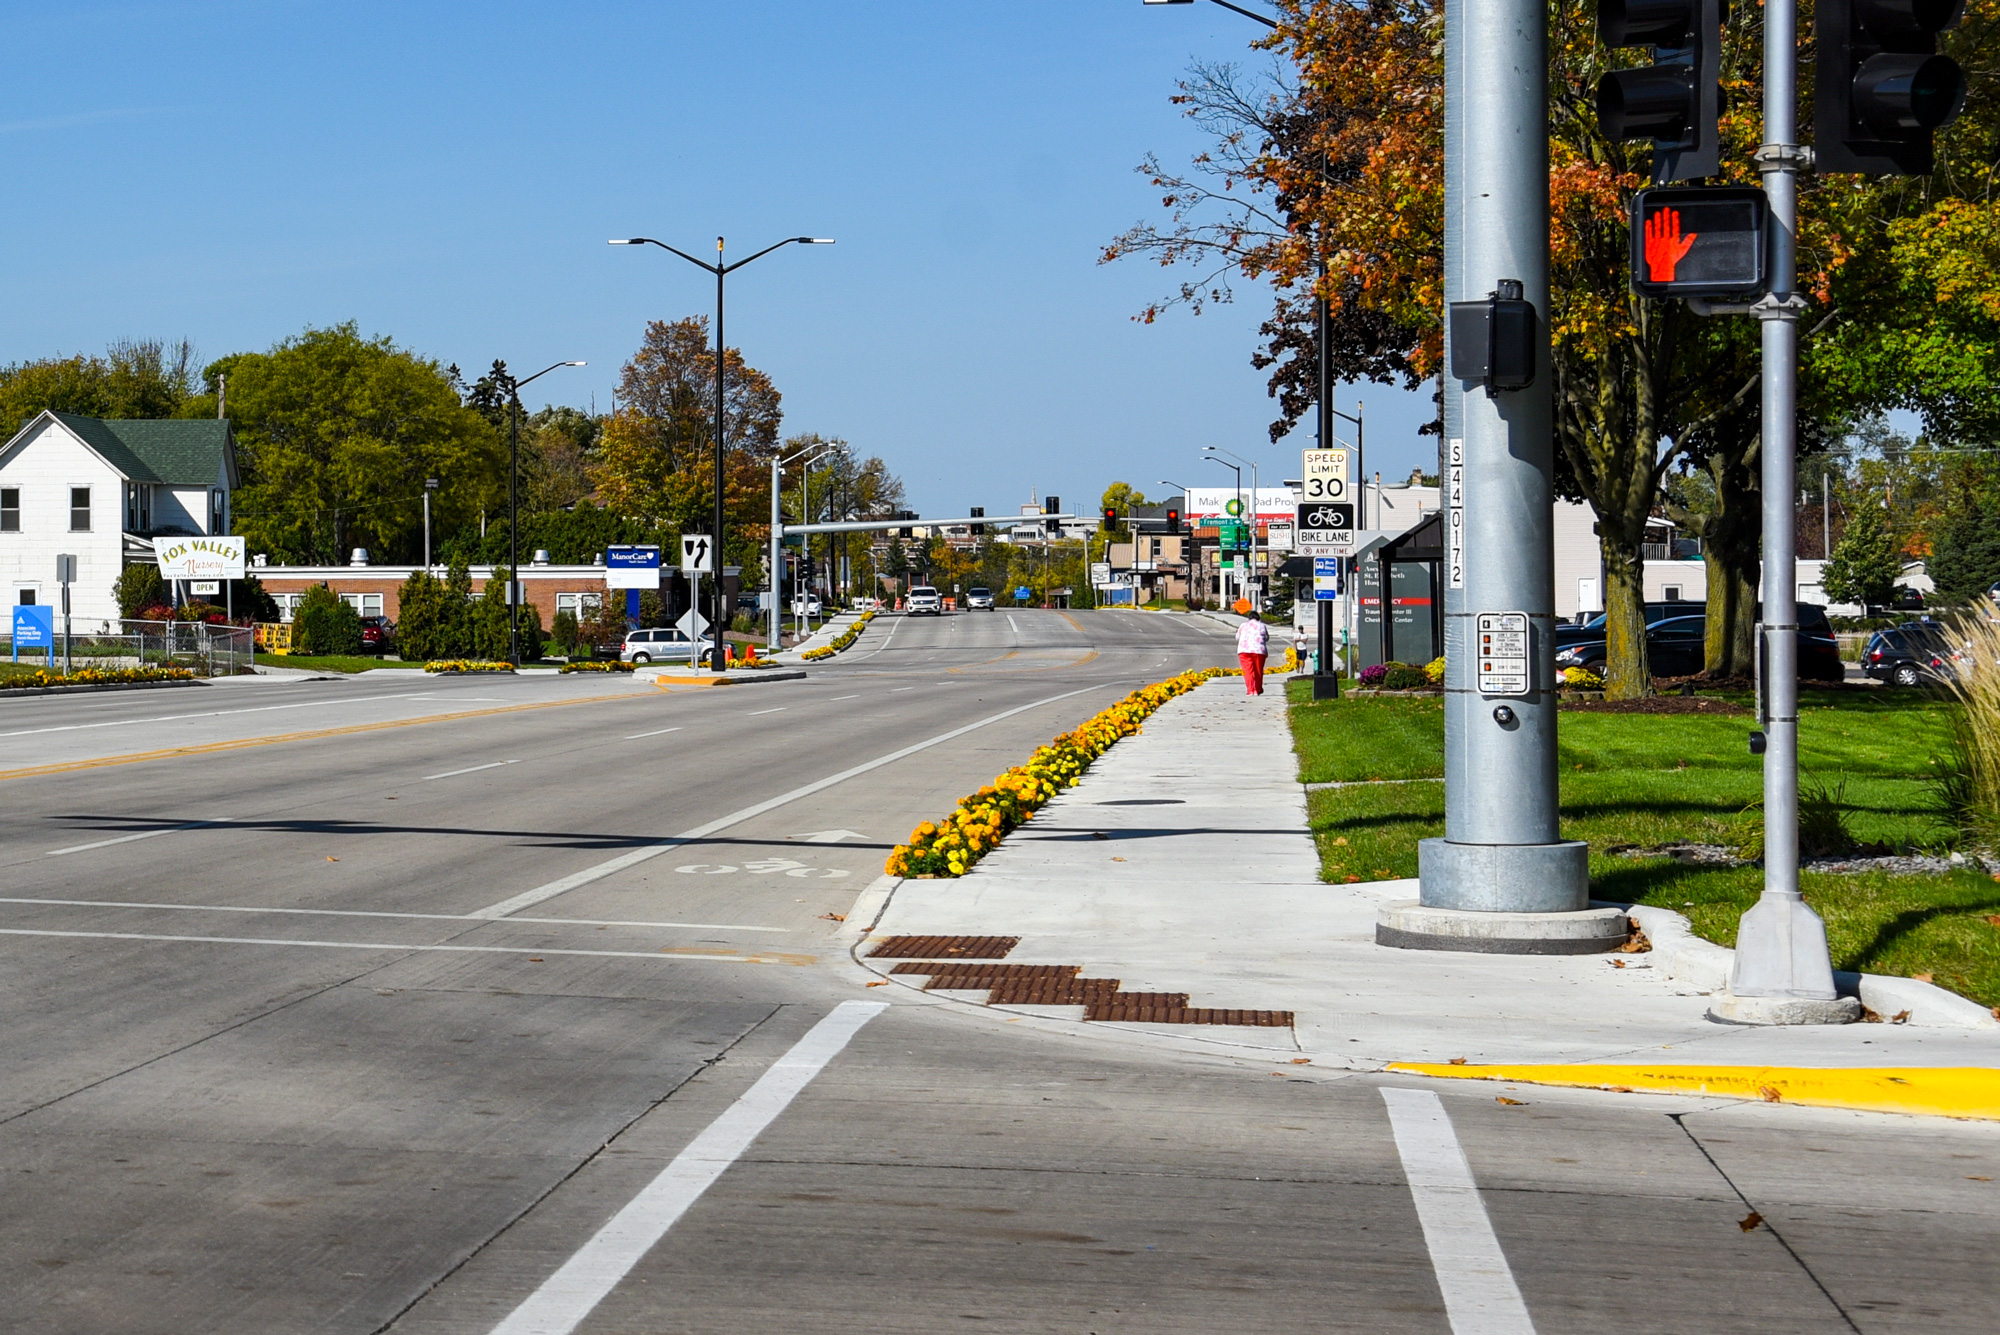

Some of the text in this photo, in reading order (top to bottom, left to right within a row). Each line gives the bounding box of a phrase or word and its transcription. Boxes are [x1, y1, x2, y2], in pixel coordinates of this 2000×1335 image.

[1307, 454, 1344, 463] SPEED
[1311, 465, 1340, 473] LIMIT
[1308, 478, 1343, 497] 30
[1301, 532, 1350, 542] BIKE LANE
[162, 540, 241, 564] FOX VALLEY
[612, 552, 647, 560] ManorCare
[182, 559, 224, 575] Nursery
[196, 584, 214, 592] OPEN
